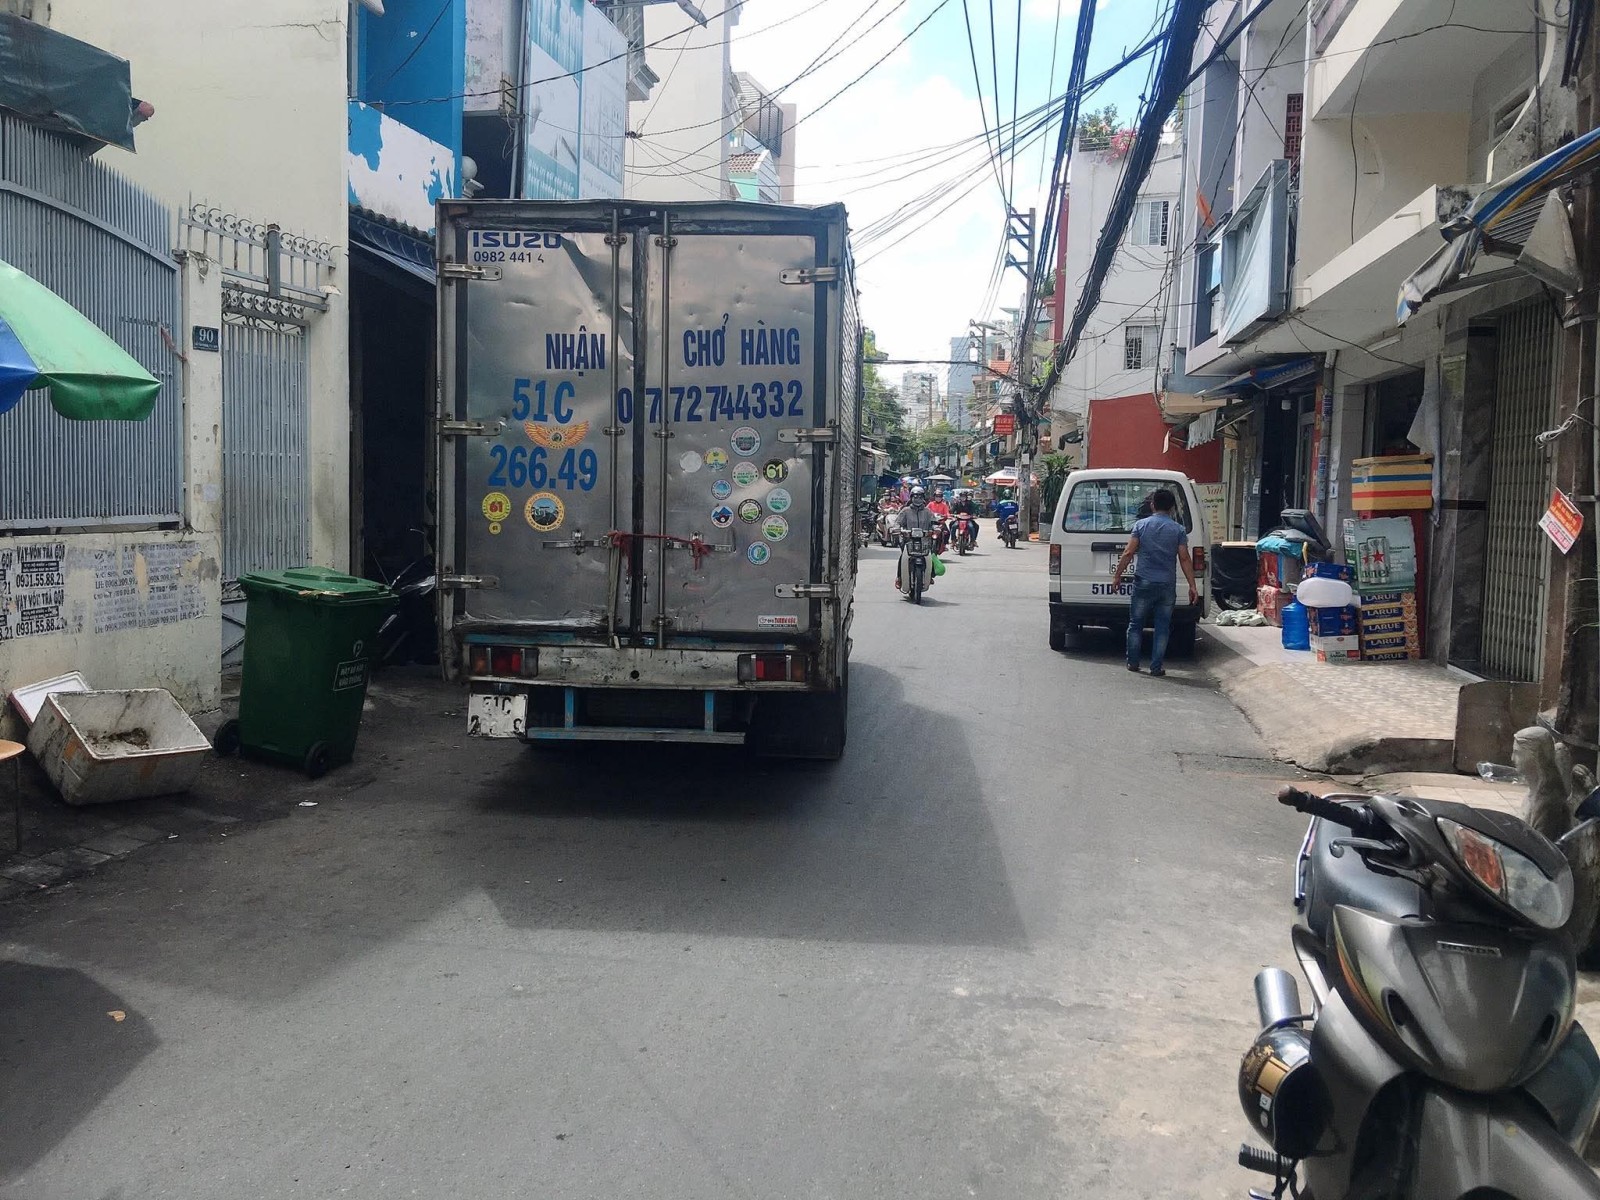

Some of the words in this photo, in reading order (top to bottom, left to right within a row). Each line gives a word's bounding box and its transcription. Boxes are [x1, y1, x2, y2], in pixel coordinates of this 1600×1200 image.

[473, 231, 562, 249] ISUZU
[473, 251, 505, 262] 0982
[509, 252, 532, 263] 441
[199, 328, 214, 343] 90
[545, 325, 606, 377] NHẬN
[683, 312, 730, 368] CHỞ
[740, 319, 801, 366] HÀNG
[511, 378, 576, 424] 51C
[488, 444, 598, 491] 266.49
[766, 463, 783, 479] 61
[1365, 593, 1398, 602] LARUE
[1367, 607, 1399, 616] LARUE
[1369, 622, 1401, 631] LARUE
[1371, 637, 1403, 646] LARUE
